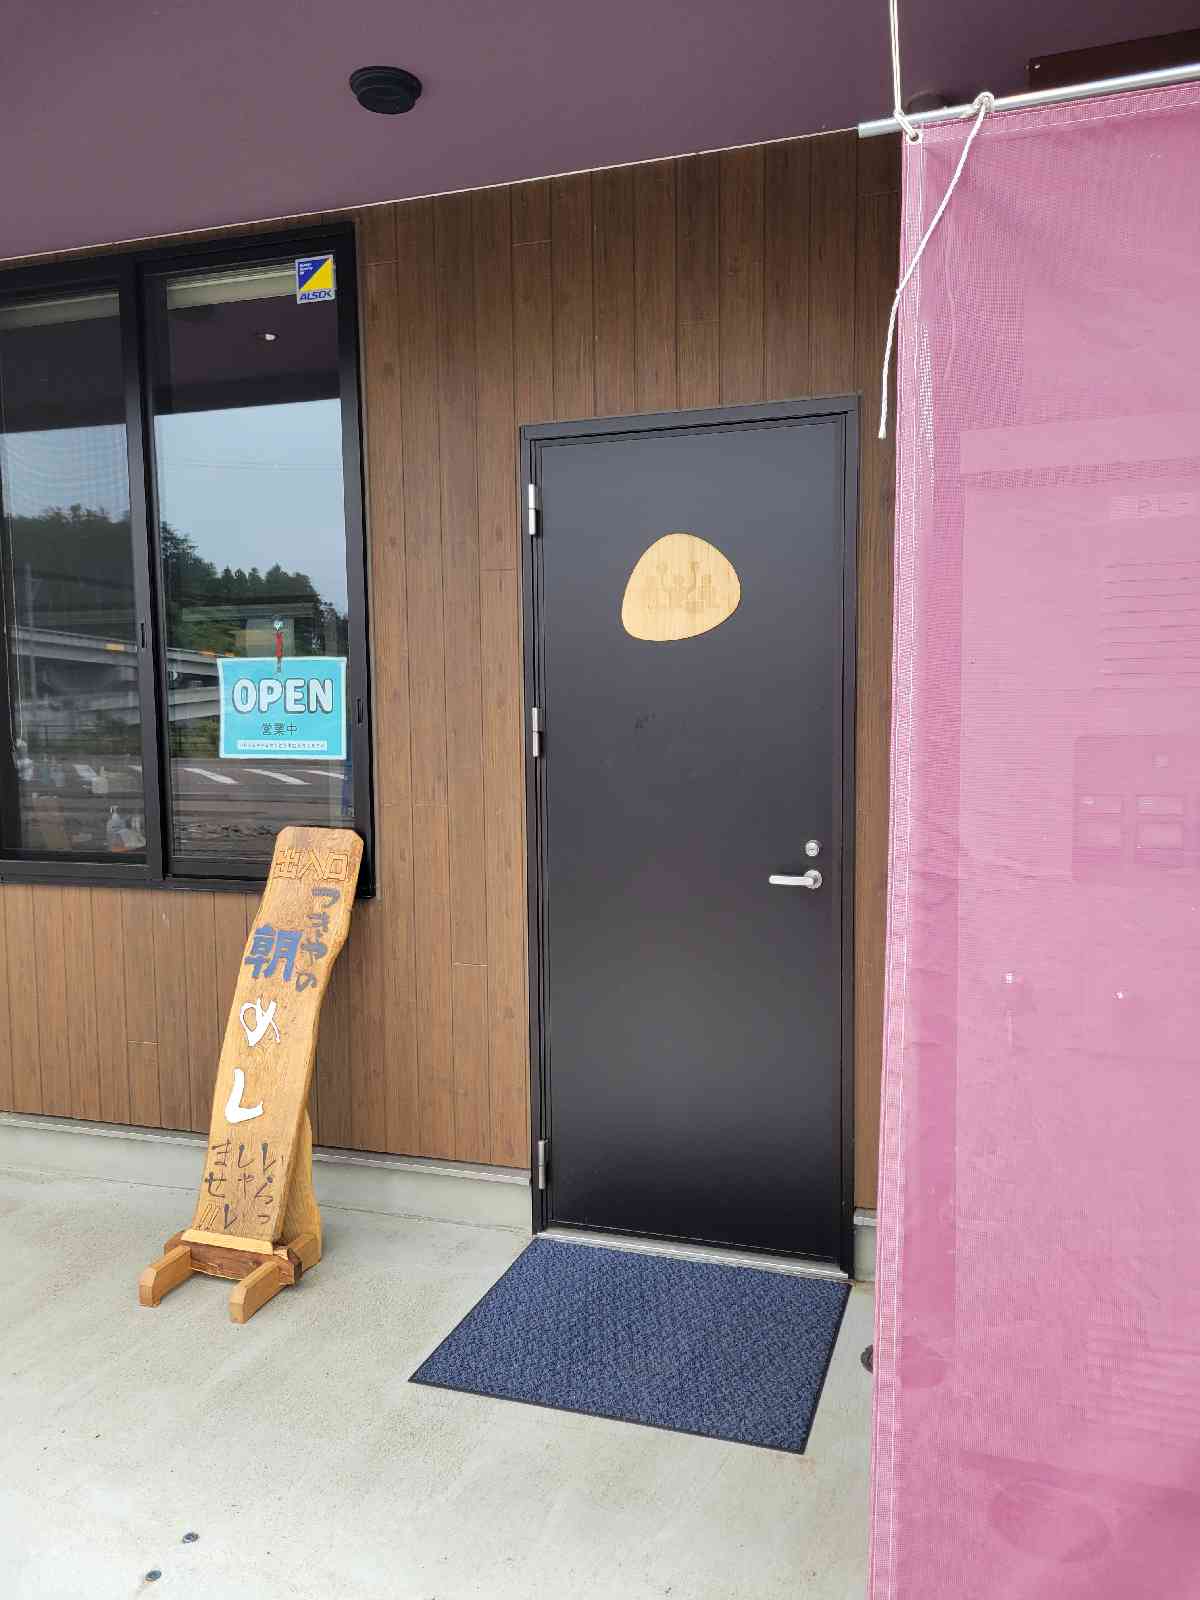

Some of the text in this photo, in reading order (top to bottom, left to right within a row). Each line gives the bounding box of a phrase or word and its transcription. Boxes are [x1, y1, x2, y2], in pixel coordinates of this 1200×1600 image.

[300, 289, 333, 300] ALSOK
[232, 678, 334, 714] OPEN
[262, 721, 298, 736] 営業中
[271, 847, 351, 882] 出入口
